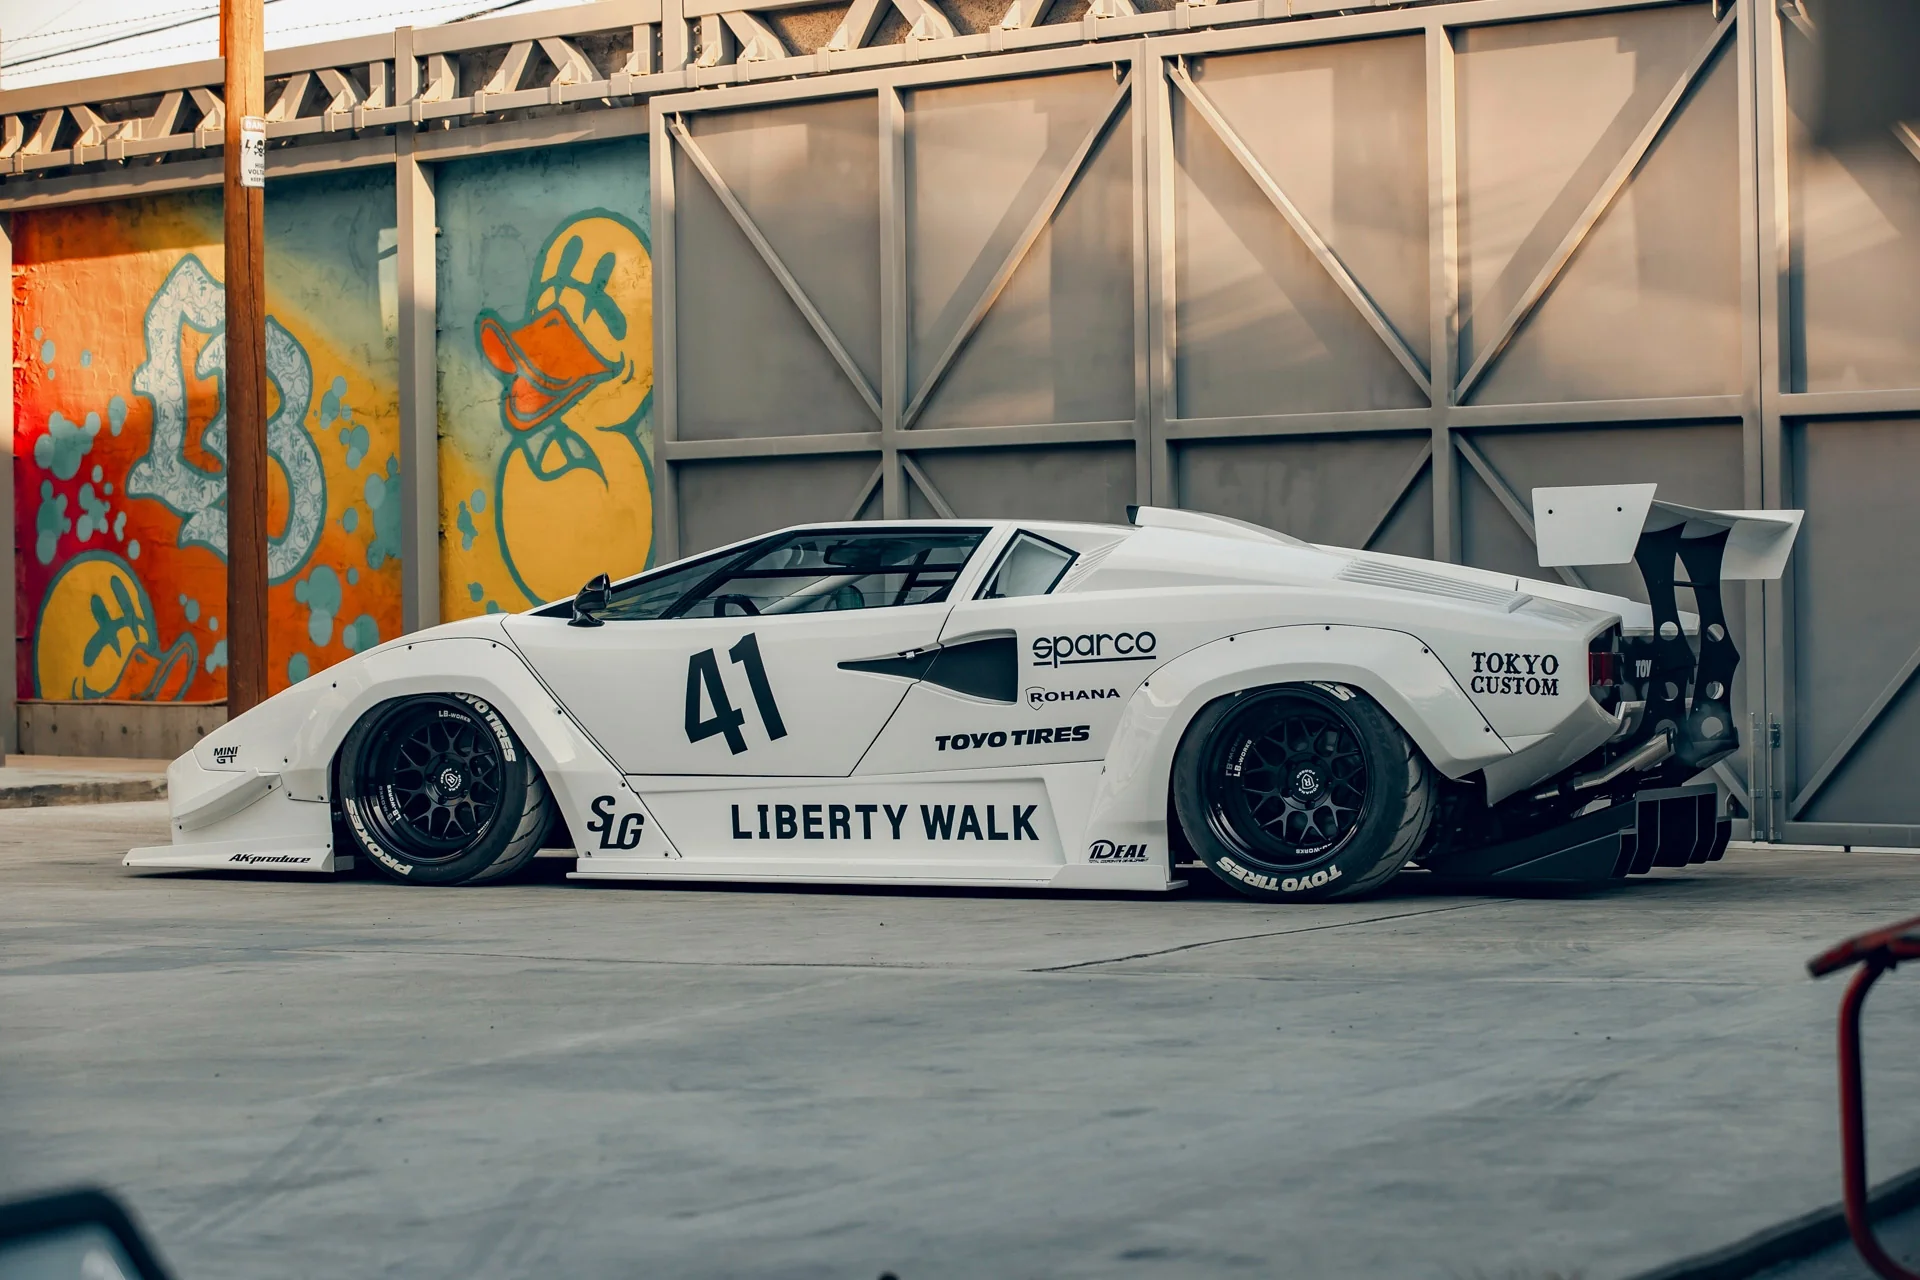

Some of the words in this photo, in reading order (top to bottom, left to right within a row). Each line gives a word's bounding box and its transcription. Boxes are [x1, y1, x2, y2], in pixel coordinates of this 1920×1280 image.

[1032, 630, 1156, 668] sparco
[1470, 651, 1560, 676] TOKYO
[684, 632, 788, 756] 41
[1030, 687, 1120, 703] ROHANA
[1470, 675, 1560, 696] CUSTOM
[485, 710, 517, 762] TIRES
[935, 730, 1006, 751] TOYO
[1010, 724, 1090, 746] TIRES
[214, 746, 238, 756] MINI
[216, 755, 236, 764] GT
[731, 804, 908, 840] LIBERTY
[920, 804, 1040, 841] WALK
[346, 798, 413, 876] PROXES
[228, 854, 312, 864] AK-produce
[1216, 856, 1280, 892] TIRES
[1281, 864, 1342, 892] TOYO
